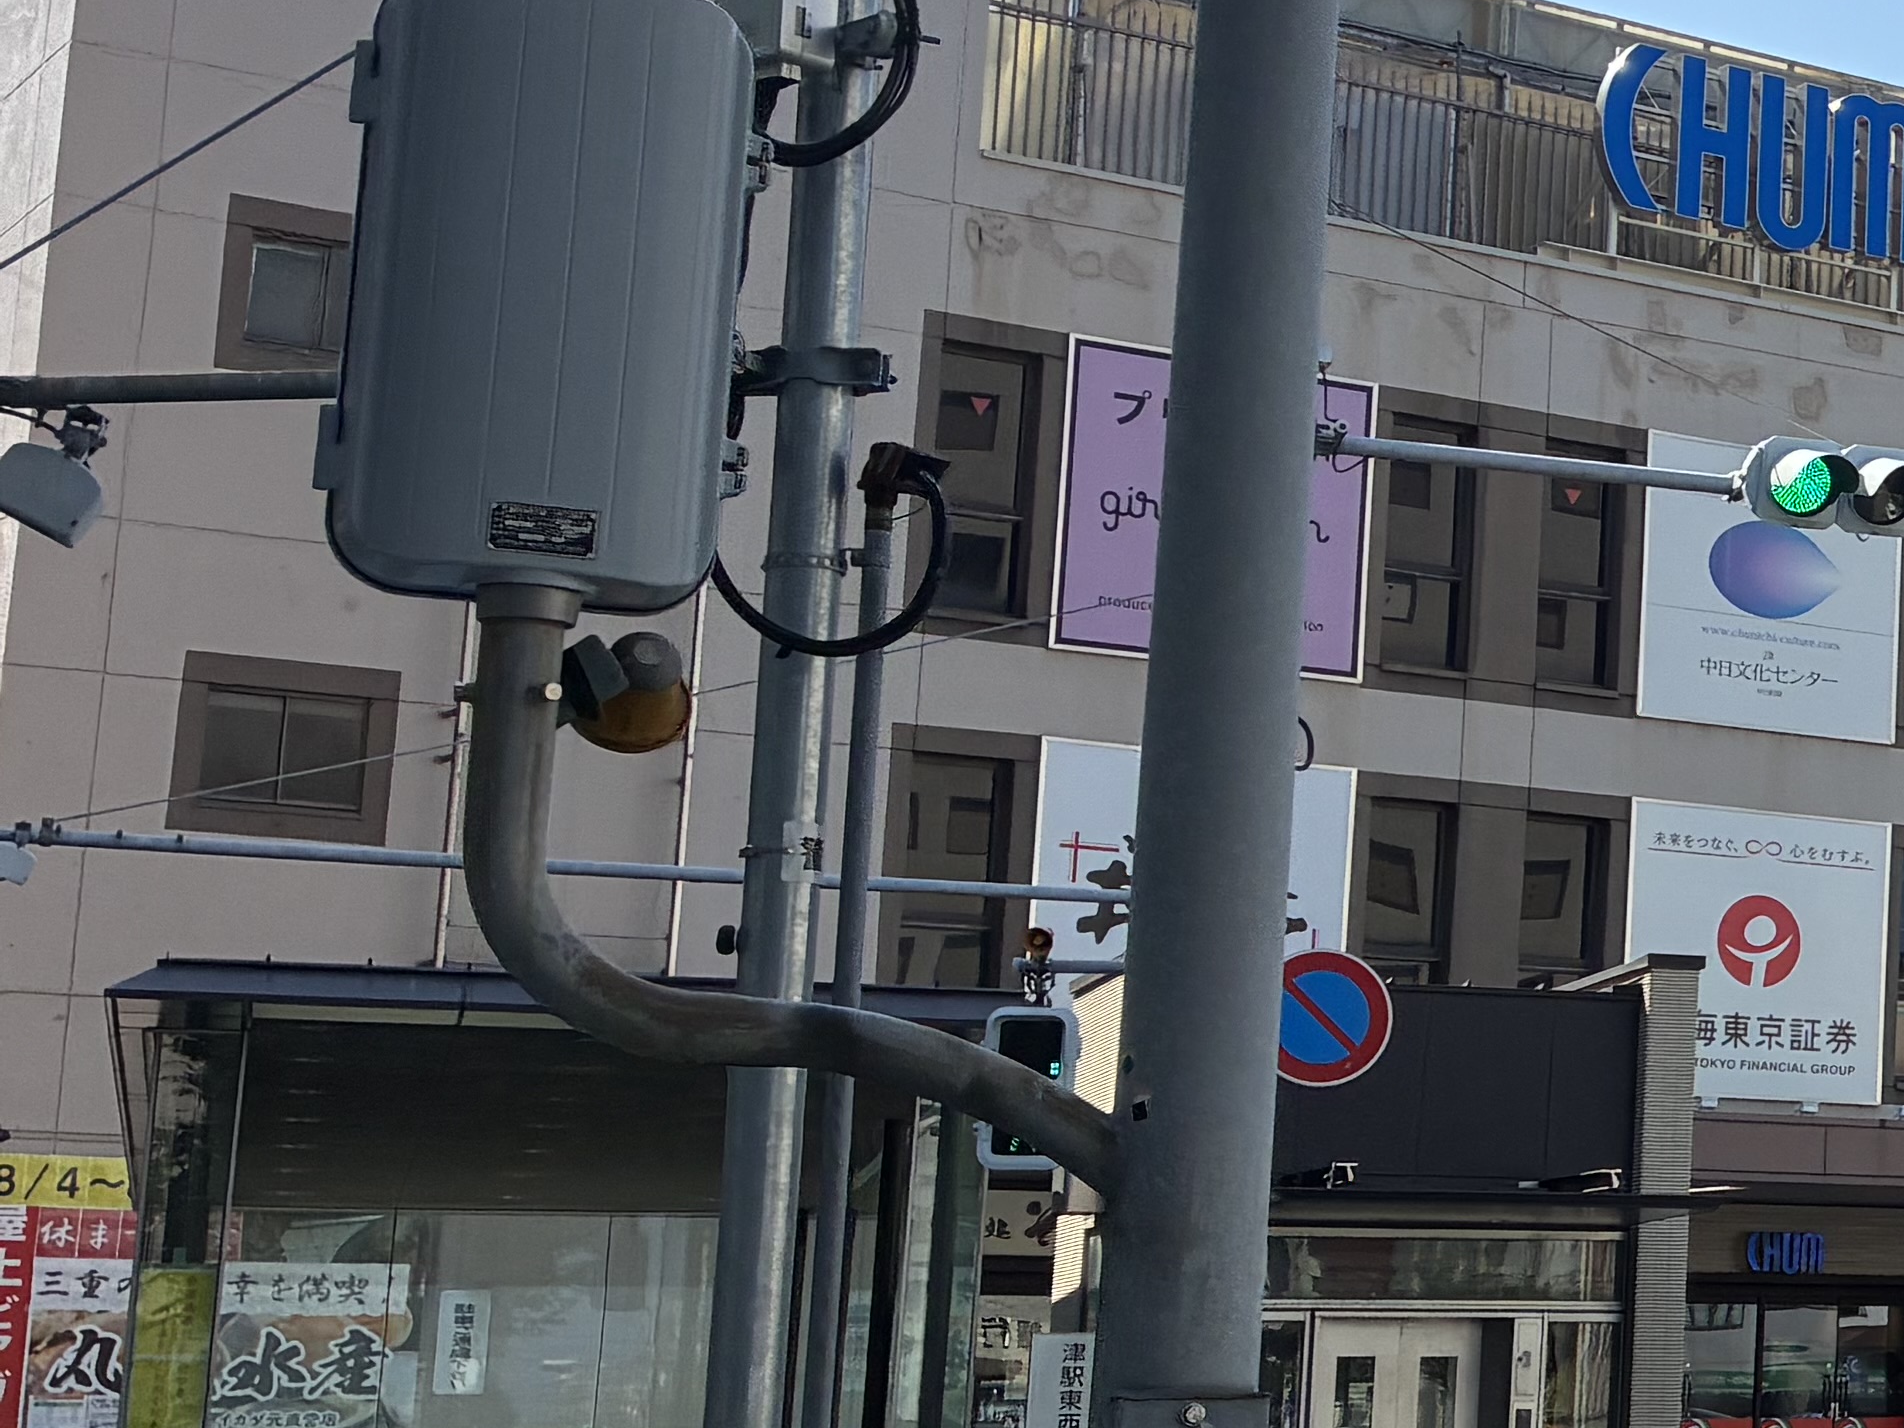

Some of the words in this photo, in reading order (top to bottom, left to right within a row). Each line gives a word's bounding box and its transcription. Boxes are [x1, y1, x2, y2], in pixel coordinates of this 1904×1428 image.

[1700, 656, 1839, 687] 中日文化センター
[1695, 1008, 1858, 1055] 海東京証券
[1739, 1059, 1807, 1074] FINANCIAL
[1810, 1063, 1856, 1076] GROUP
[1746, 1230, 1826, 1274] CHUM
